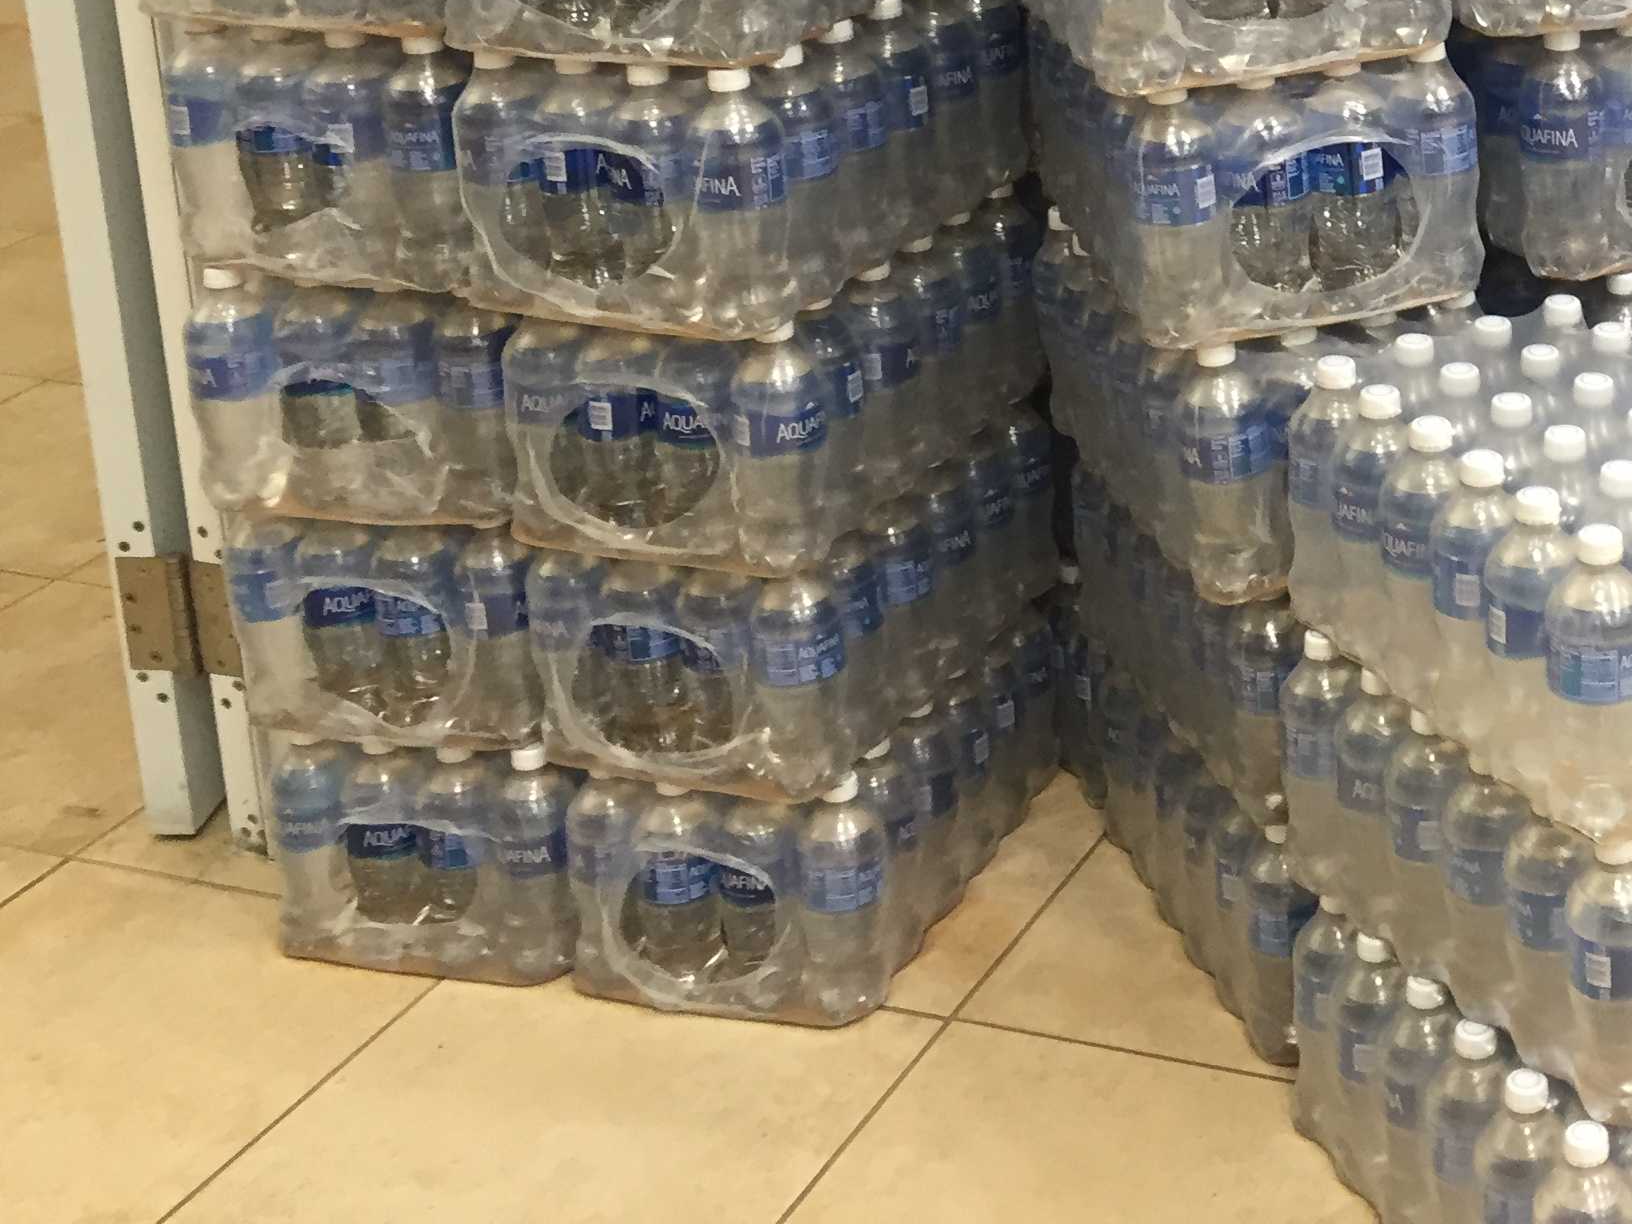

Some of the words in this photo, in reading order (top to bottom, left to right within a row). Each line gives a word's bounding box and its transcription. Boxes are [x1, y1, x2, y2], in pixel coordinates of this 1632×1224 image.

[1521, 128, 1578, 149] QUAFINA
[700, 176, 740, 197] FINA
[663, 414, 705, 438] AQUA
[776, 414, 827, 439] AQUAF
[363, 827, 411, 847] AQUA
[504, 847, 551, 863] AFINA
